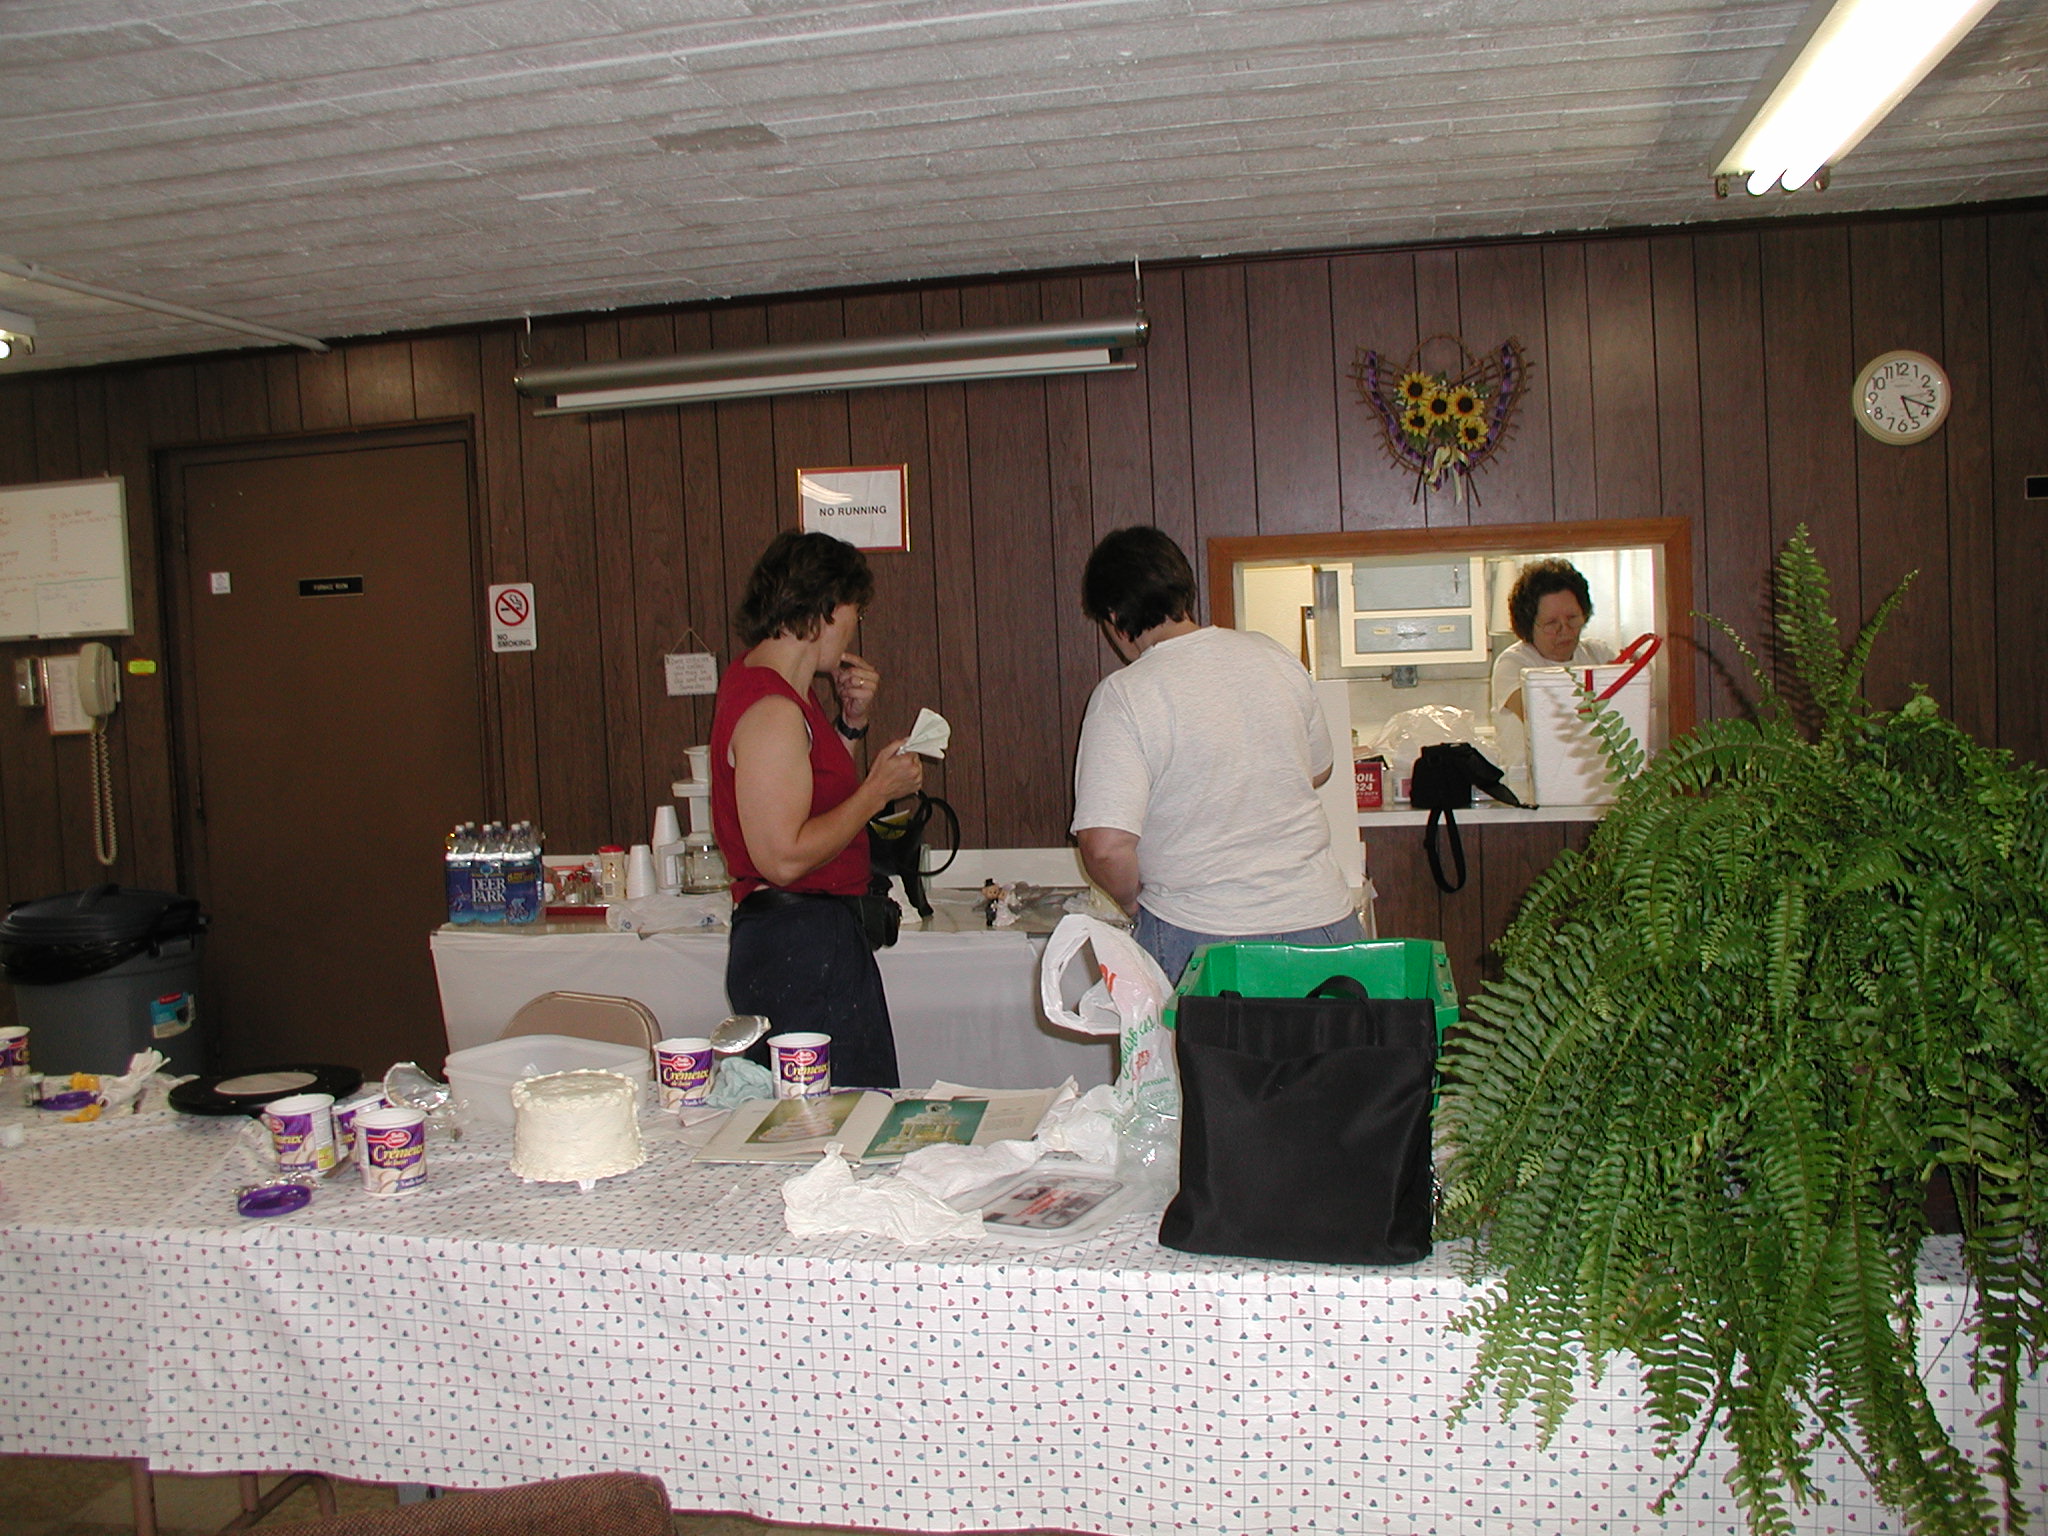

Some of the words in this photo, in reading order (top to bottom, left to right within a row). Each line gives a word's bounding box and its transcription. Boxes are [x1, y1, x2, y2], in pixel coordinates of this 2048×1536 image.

[1884, 366, 1893, 379] 11
[1896, 362, 1909, 376] 12
[1913, 365, 1918, 379] 1
[1872, 376, 1885, 390] 10
[1921, 374, 1931, 388] 2
[1868, 392, 1878, 405] 9
[1926, 390, 1936, 403] 3
[1874, 407, 1883, 420] 8
[1921, 405, 1930, 418] 4
[1886, 417, 1895, 430] 7
[1897, 419, 1908, 433] 6
[1911, 416, 1920, 430] 5
[819, 507, 835, 517] NO
[838, 505, 887, 516] RUNNING
[497, 633, 508, 641] NO
[497, 639, 531, 648] SMOKING
[471, 877, 507, 891] DEER
[472, 889, 507, 903] PARK
